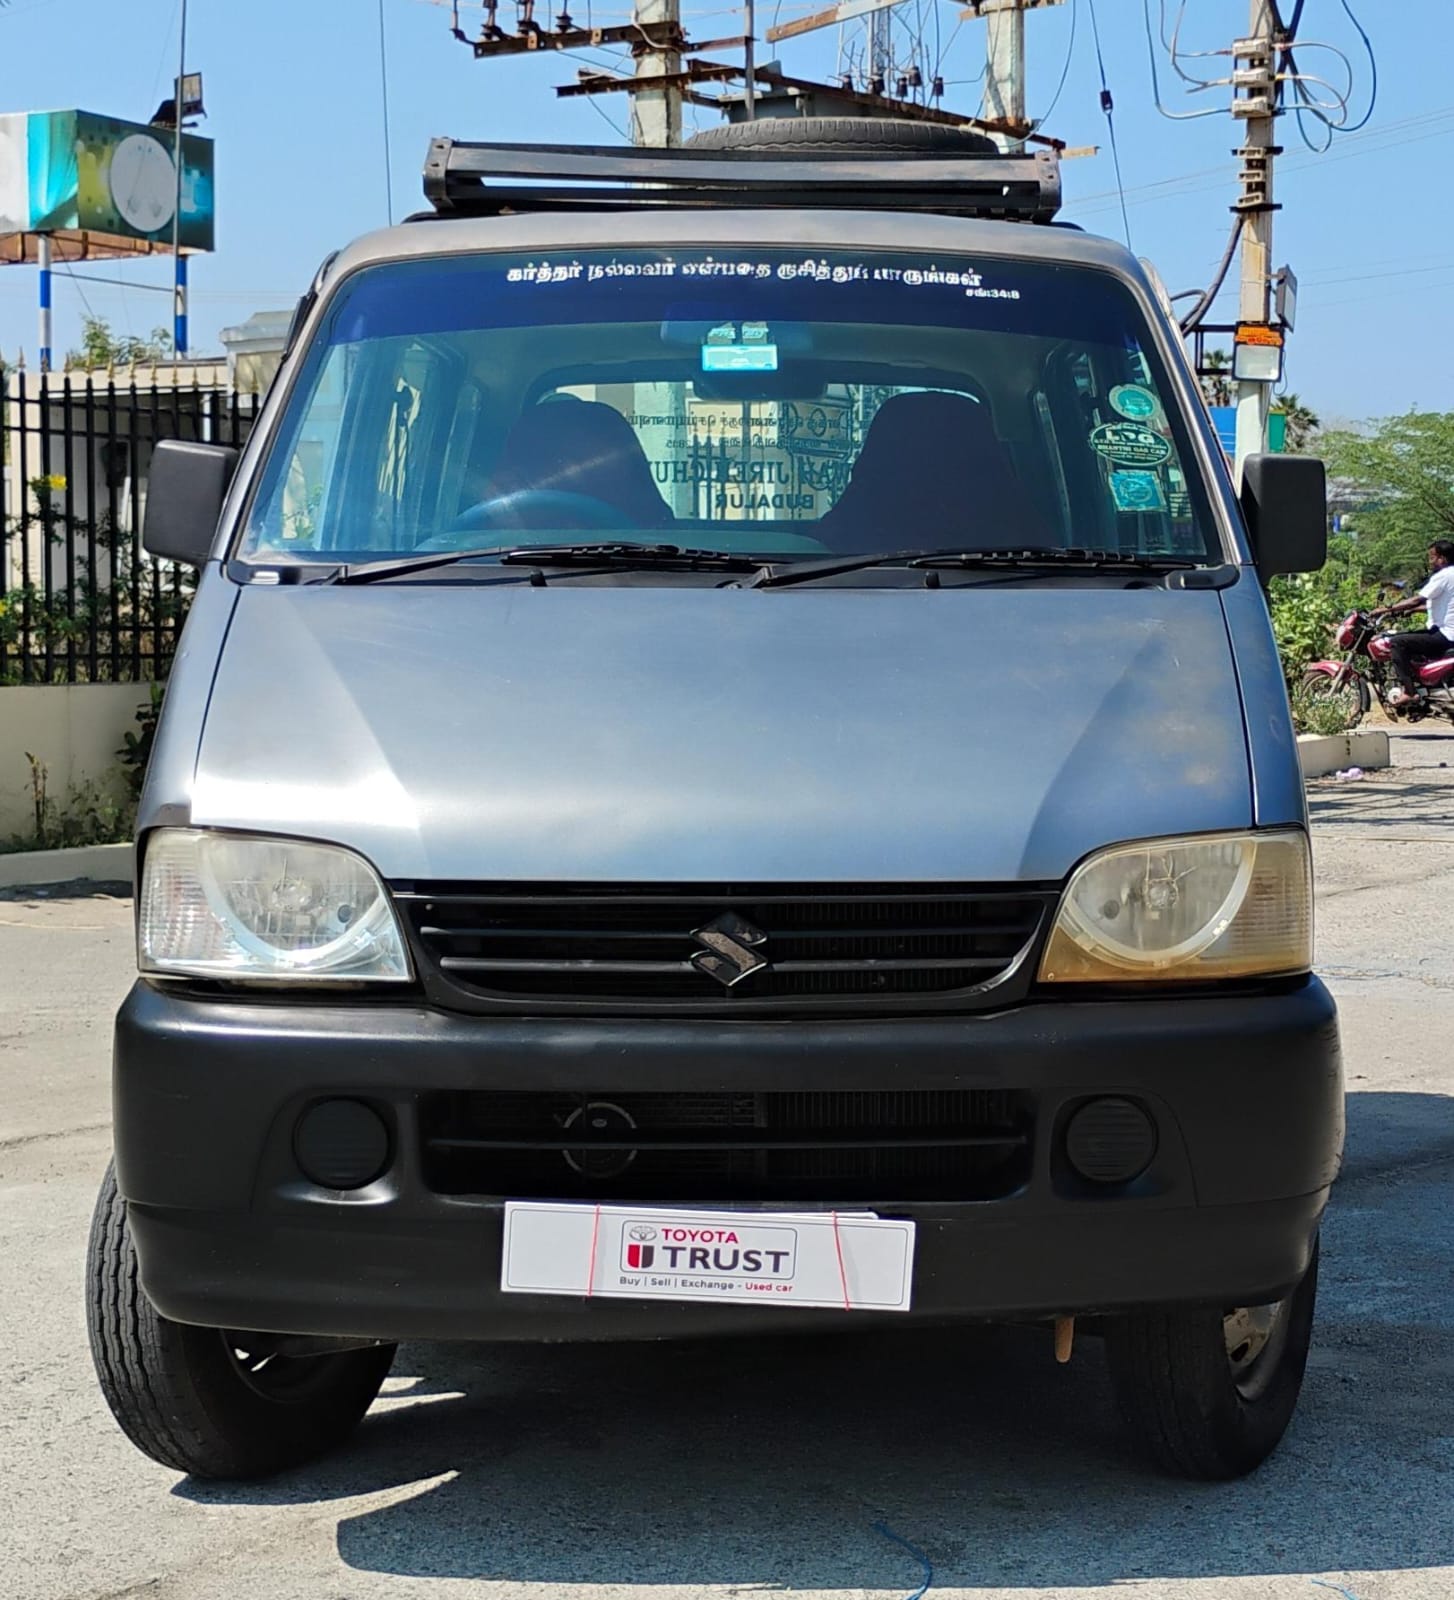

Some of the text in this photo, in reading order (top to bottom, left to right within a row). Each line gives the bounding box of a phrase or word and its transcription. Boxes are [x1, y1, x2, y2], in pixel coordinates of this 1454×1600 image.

[507, 260, 583, 284] கர்த்தர்
[661, 1228, 739, 1244] TOYOTA
[661, 1245, 790, 1273] TRUST
[619, 1276, 793, 1292] Buy Sell Exchange Used car
